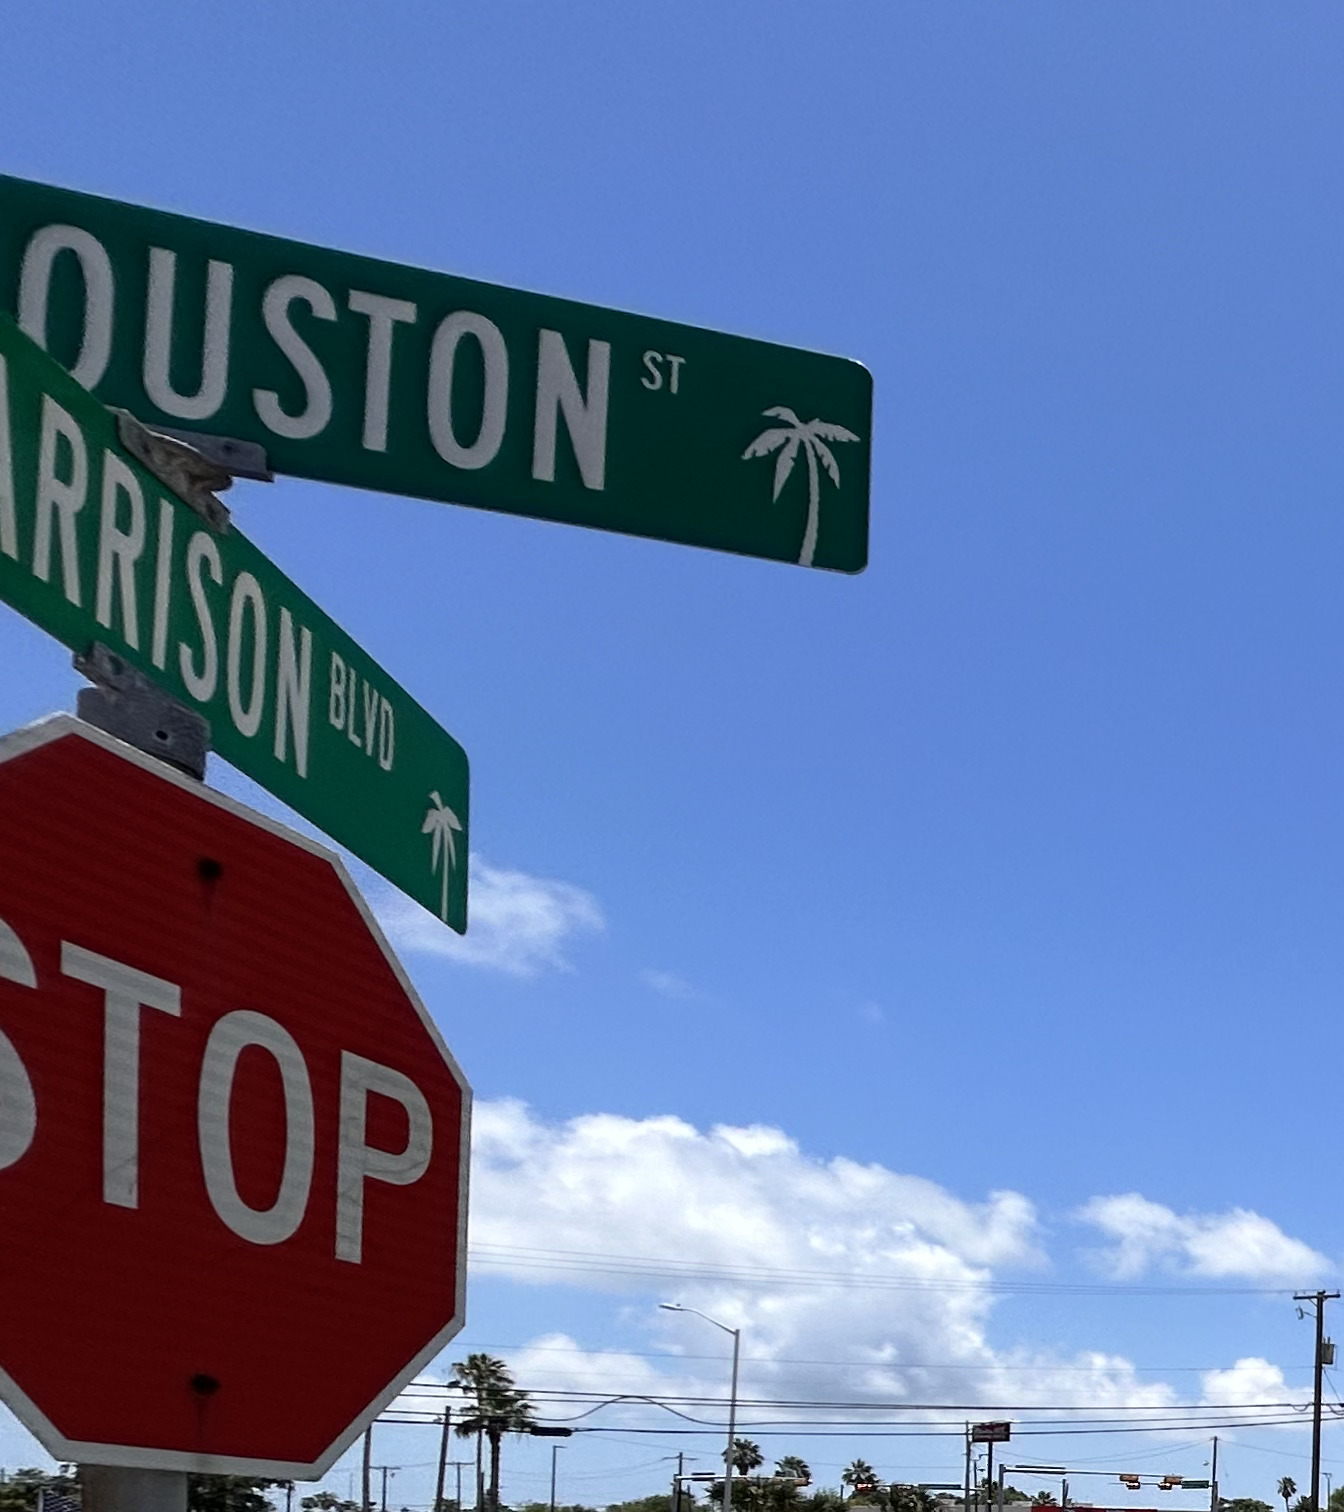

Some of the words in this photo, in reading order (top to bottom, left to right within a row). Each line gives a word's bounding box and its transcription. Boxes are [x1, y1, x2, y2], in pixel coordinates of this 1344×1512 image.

[17, 224, 611, 491] OUSTON
[641, 350, 686, 395] ST
[0, 353, 312, 778] RRISON
[330, 651, 394, 772] BLVD
